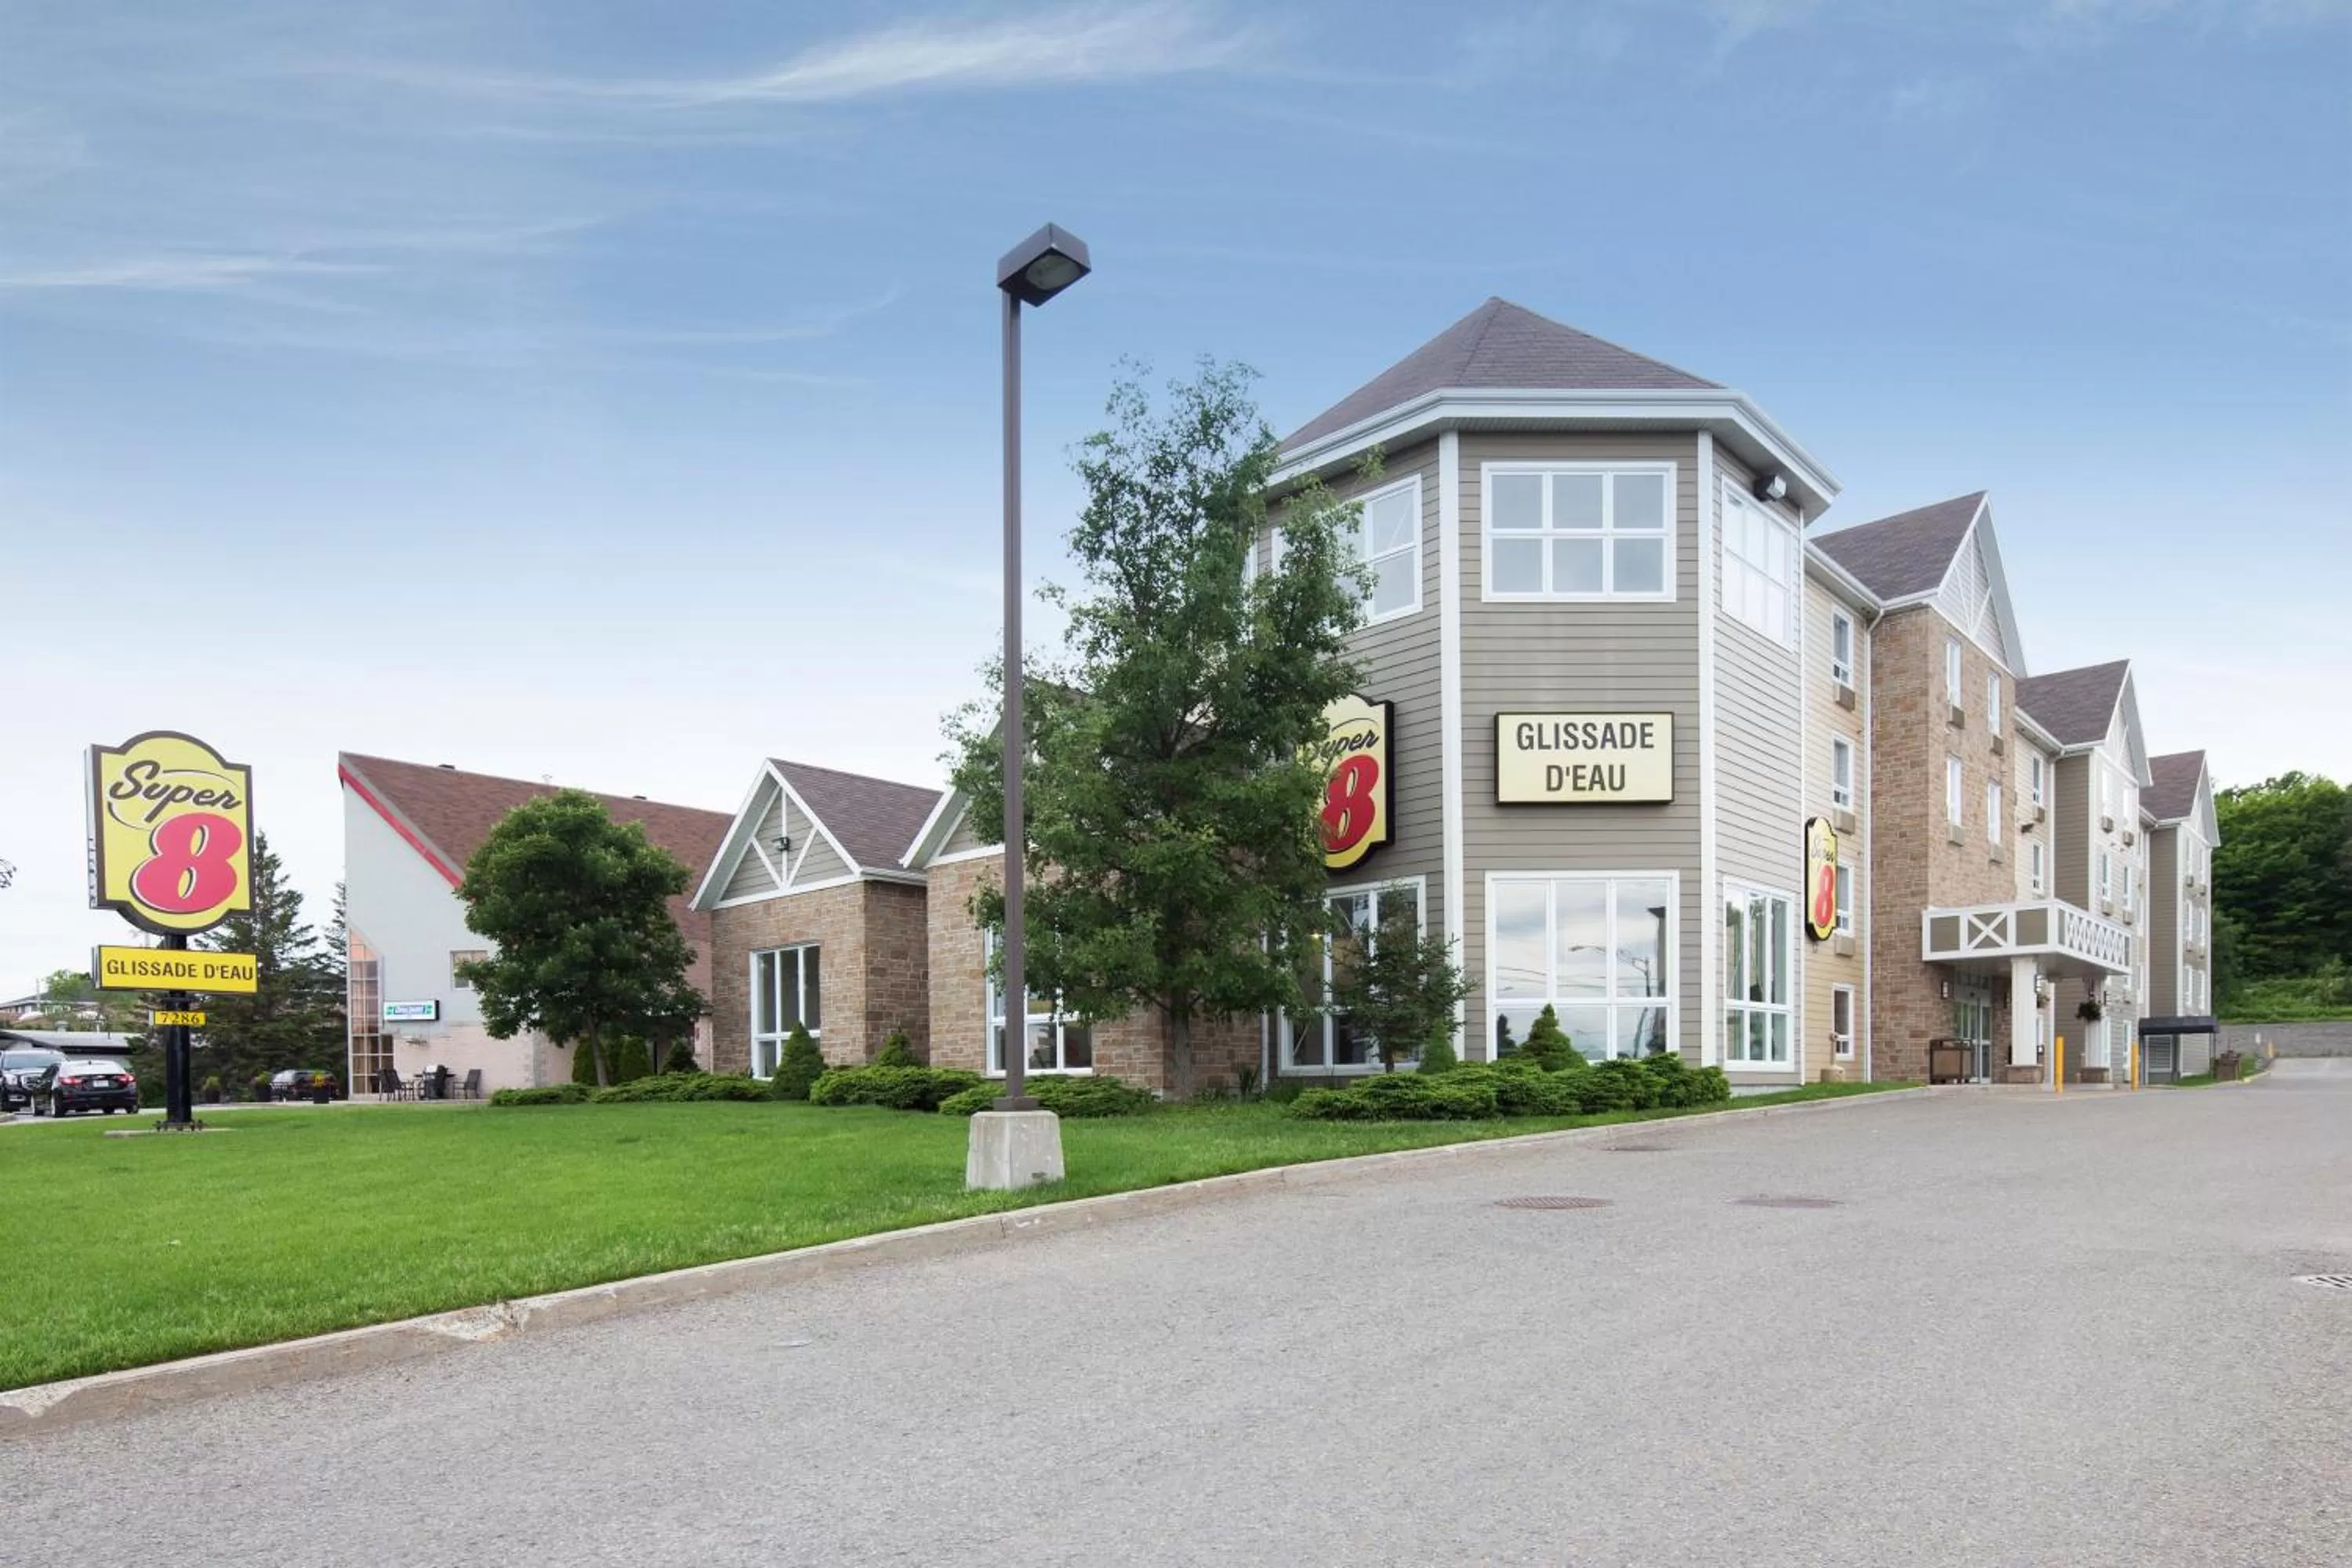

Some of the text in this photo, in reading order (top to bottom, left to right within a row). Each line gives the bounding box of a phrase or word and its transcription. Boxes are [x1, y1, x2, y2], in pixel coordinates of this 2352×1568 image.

[1516, 722, 1654, 750] GLISSADE
[109, 759, 242, 823] Super
[1545, 764, 1626, 792] D'EAU
[1319, 753, 1380, 855] 8
[129, 812, 242, 915] 8
[107, 959, 254, 981] GLISSADE D'EAU
[159, 1012, 201, 1025] 7286
